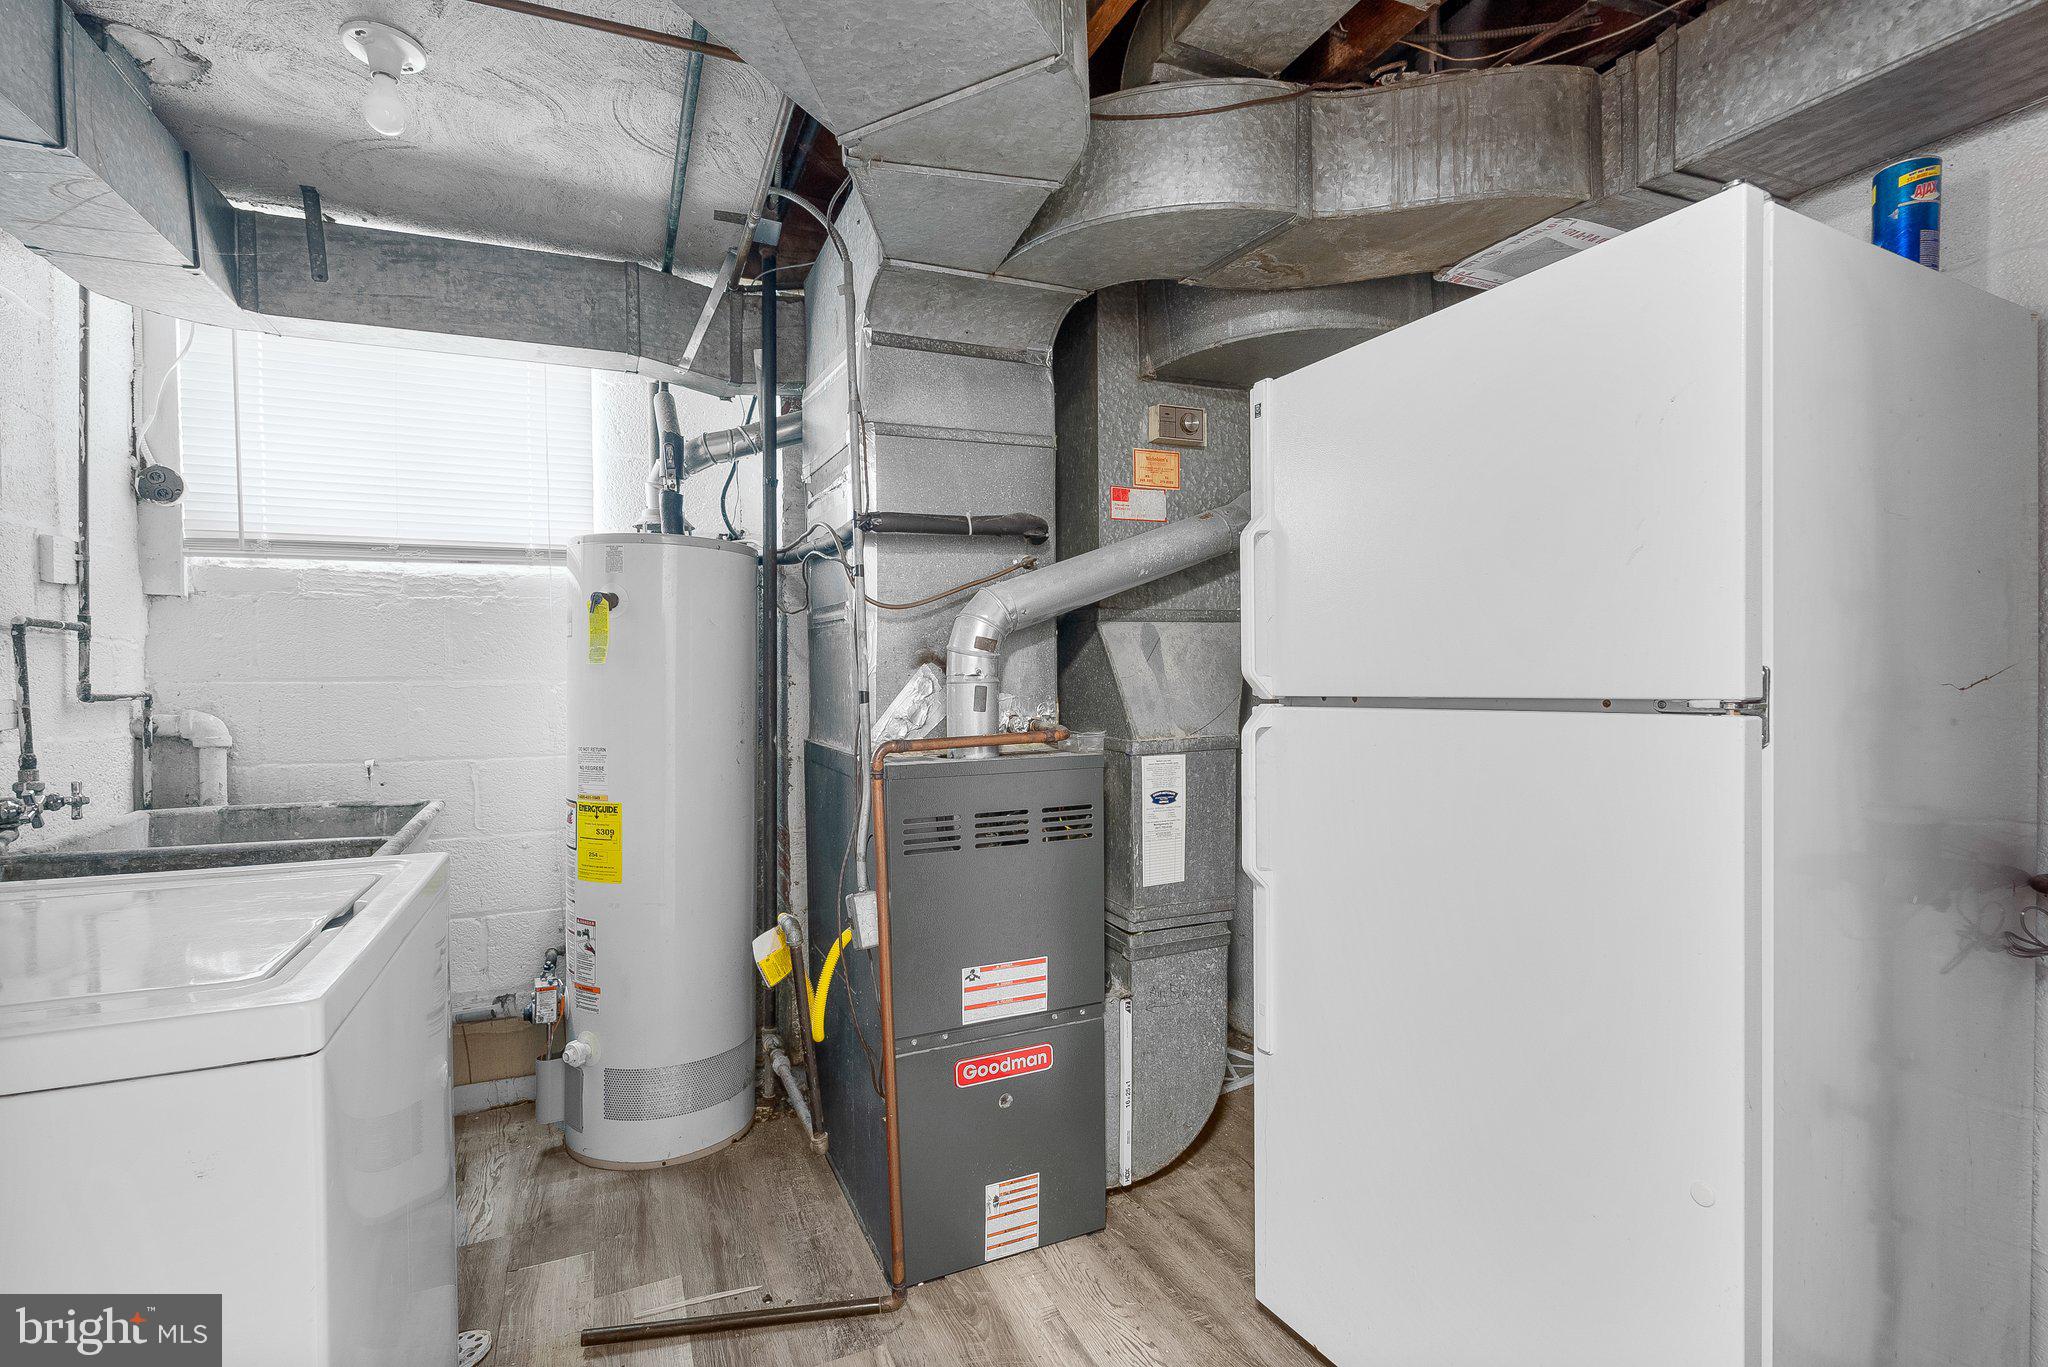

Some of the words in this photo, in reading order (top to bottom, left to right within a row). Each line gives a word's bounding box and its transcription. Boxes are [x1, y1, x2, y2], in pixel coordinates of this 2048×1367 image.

[1914, 181, 1937, 198] AJAX
[578, 804, 618, 813] ENERGYGUIDE
[596, 828, 615, 837] $309
[962, 1052, 1047, 1080] Goodman
